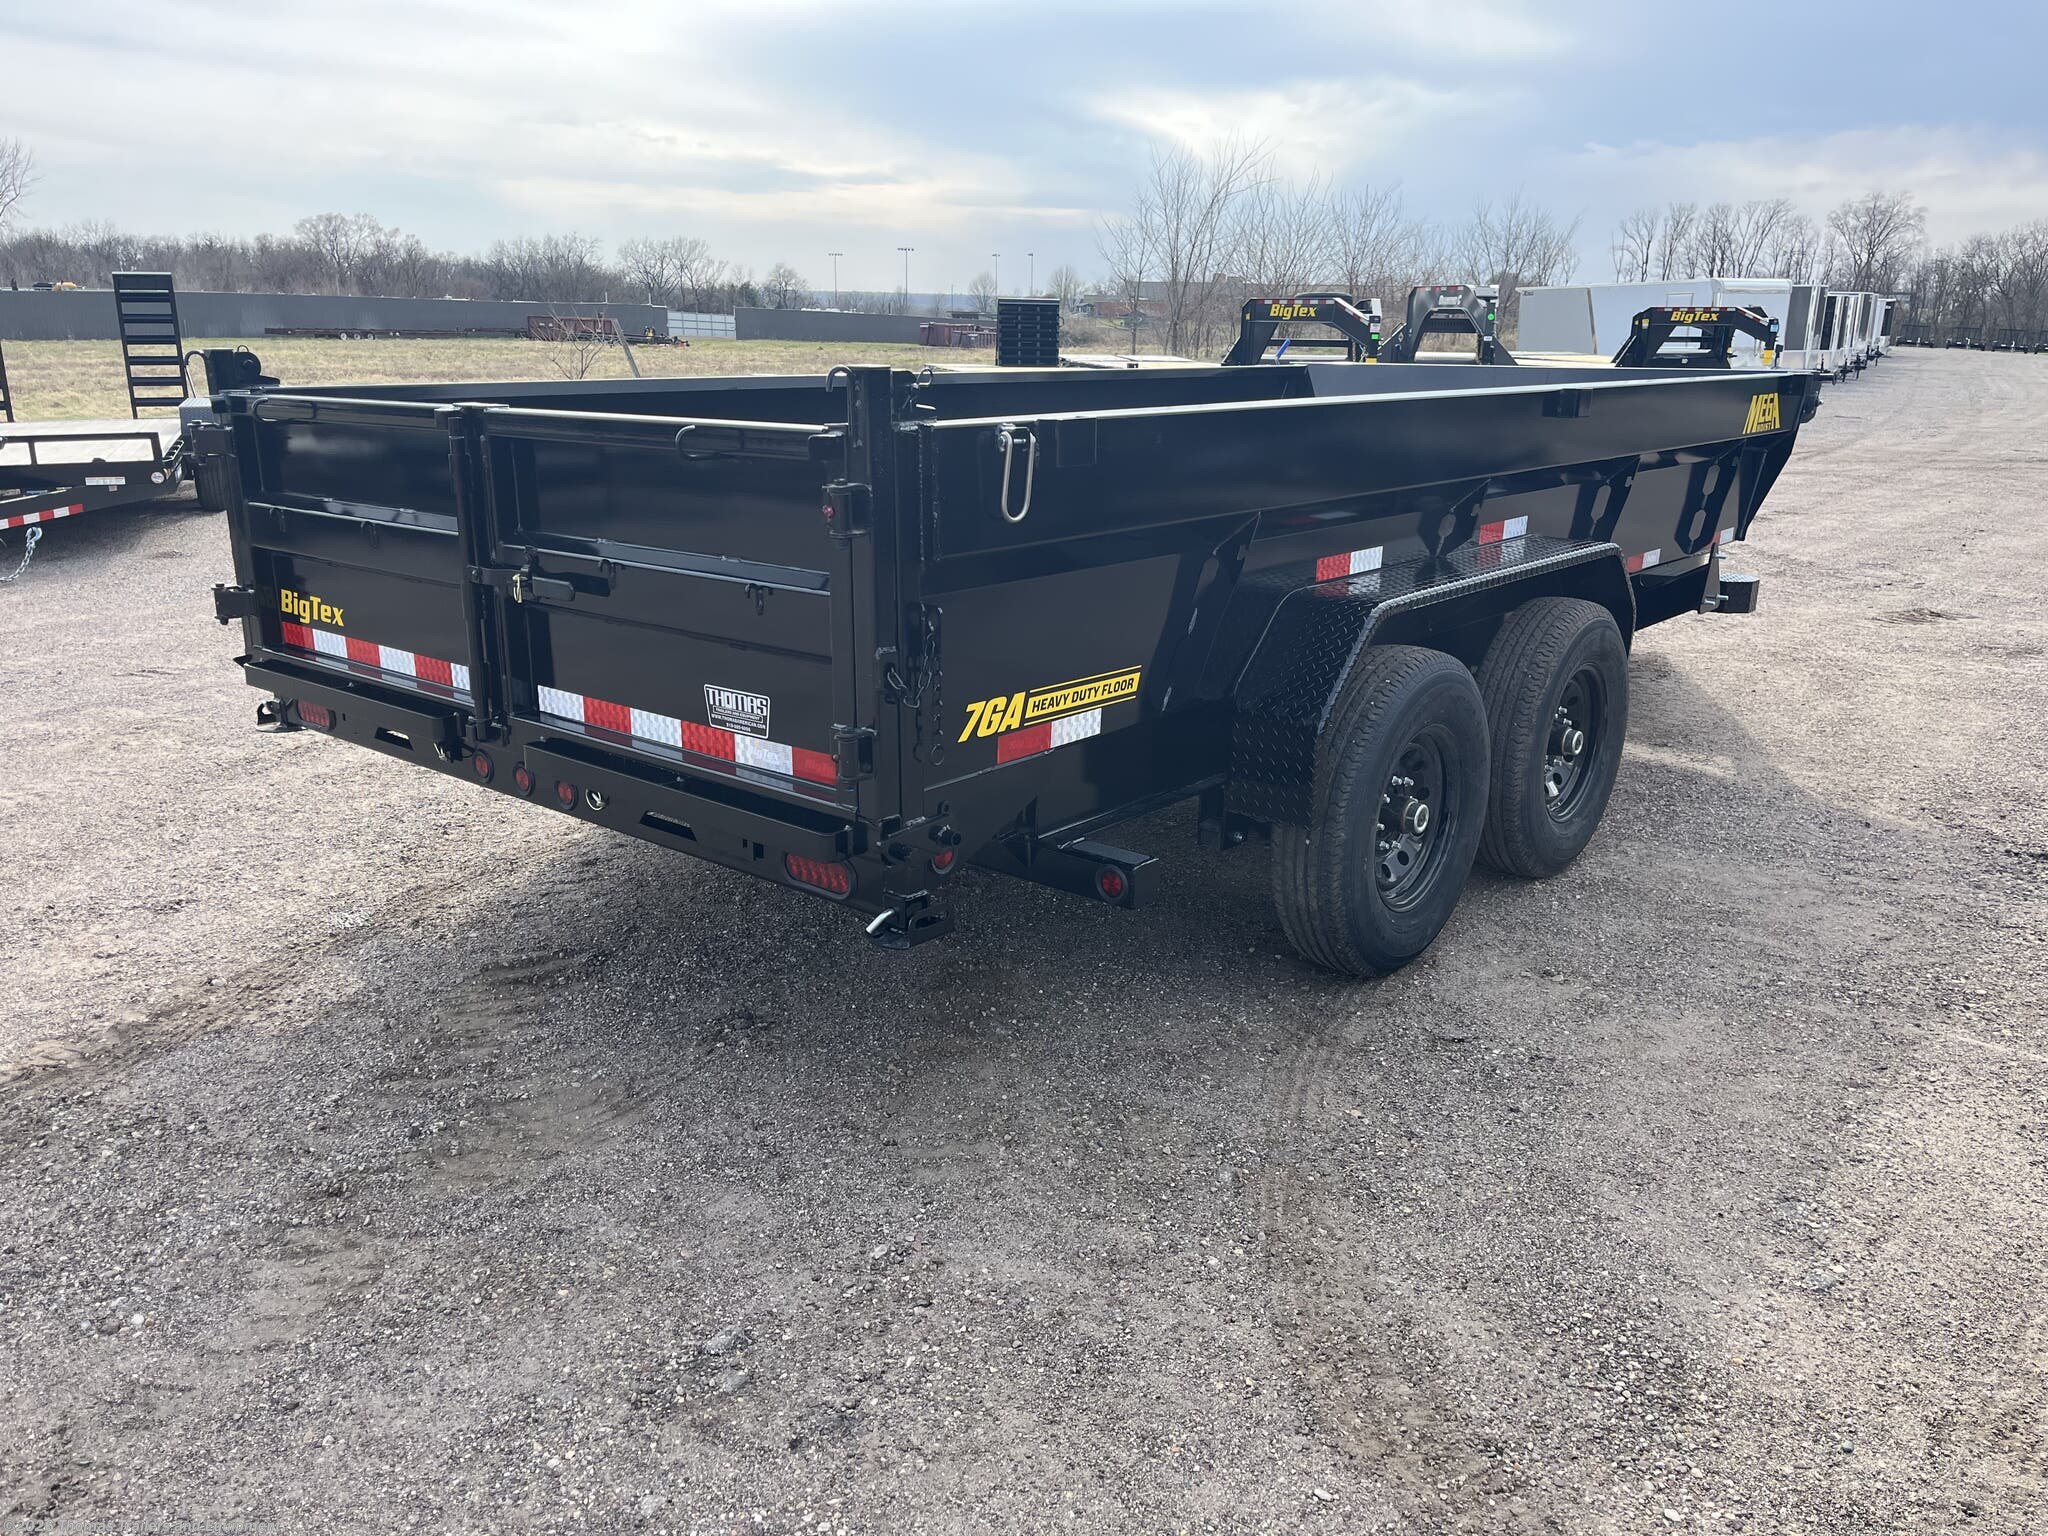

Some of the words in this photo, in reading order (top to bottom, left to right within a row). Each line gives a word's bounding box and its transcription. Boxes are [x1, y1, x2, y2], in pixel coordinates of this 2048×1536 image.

[1269, 303, 1317, 320] BigTex
[1670, 311, 1720, 324] BigTex
[1742, 392, 1780, 435] MEGA
[280, 588, 345, 627] BigTex
[706, 687, 767, 716] THOMAS
[1032, 692, 1070, 714] HEAVY
[1071, 685, 1100, 704] DUTY
[1101, 677, 1134, 696] FLOOR
[957, 691, 1026, 743] 7GA
